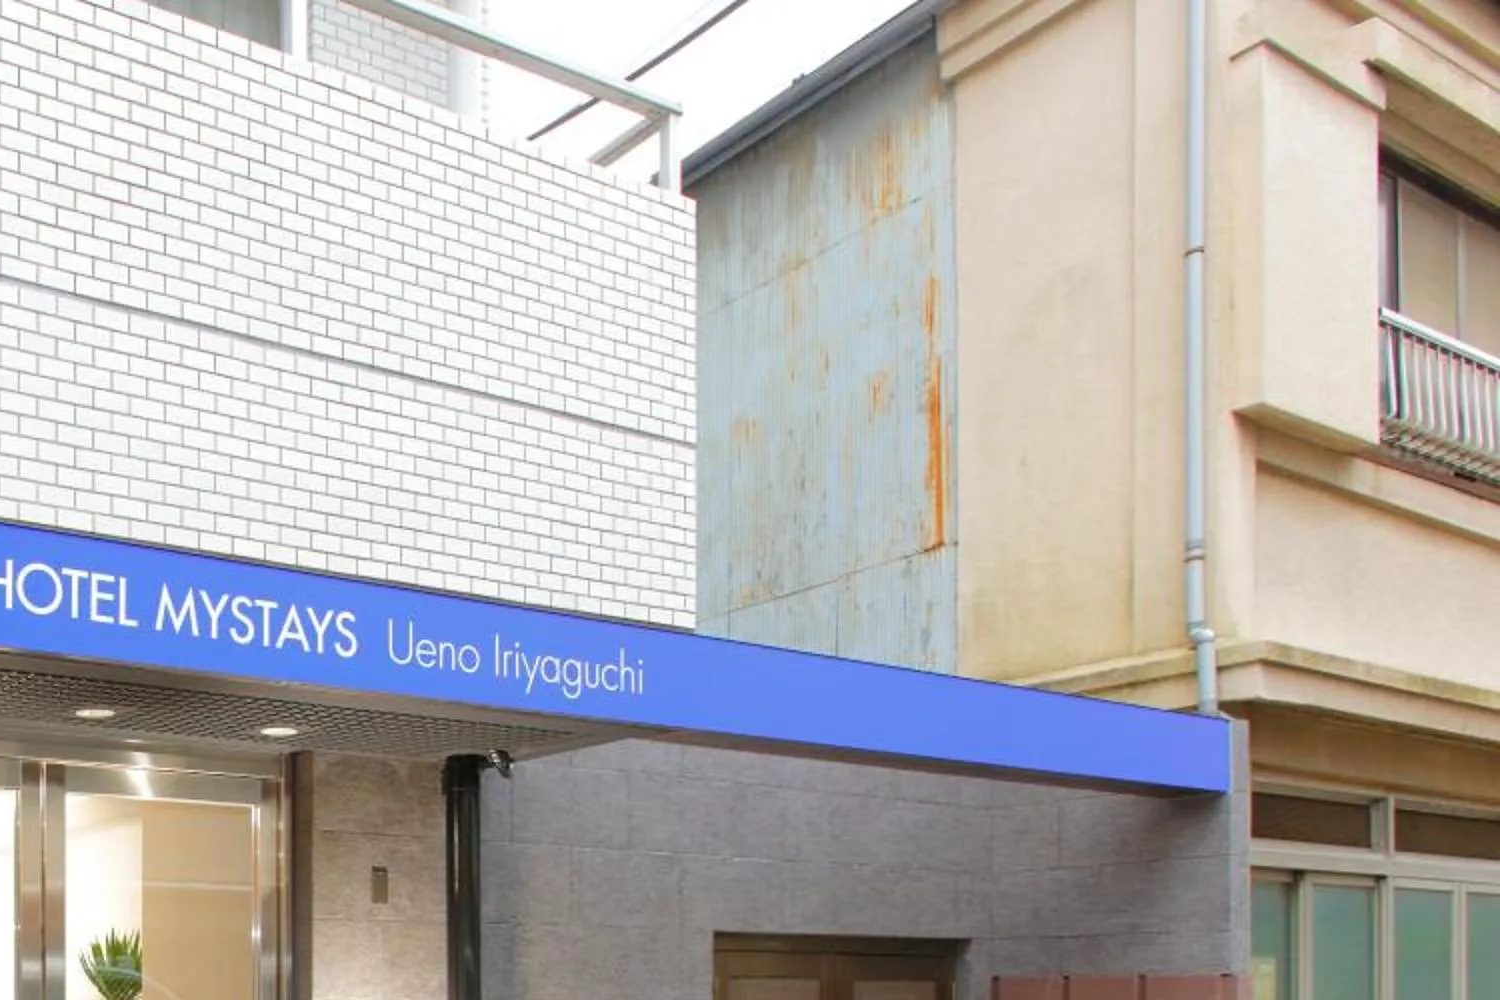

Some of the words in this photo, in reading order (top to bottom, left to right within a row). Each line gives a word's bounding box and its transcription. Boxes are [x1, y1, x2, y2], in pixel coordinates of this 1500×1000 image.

[156, 586, 356, 656] MYSTAYS
[389, 620, 480, 673] Ueno
[495, 636, 644, 699] Iriyaguchi
